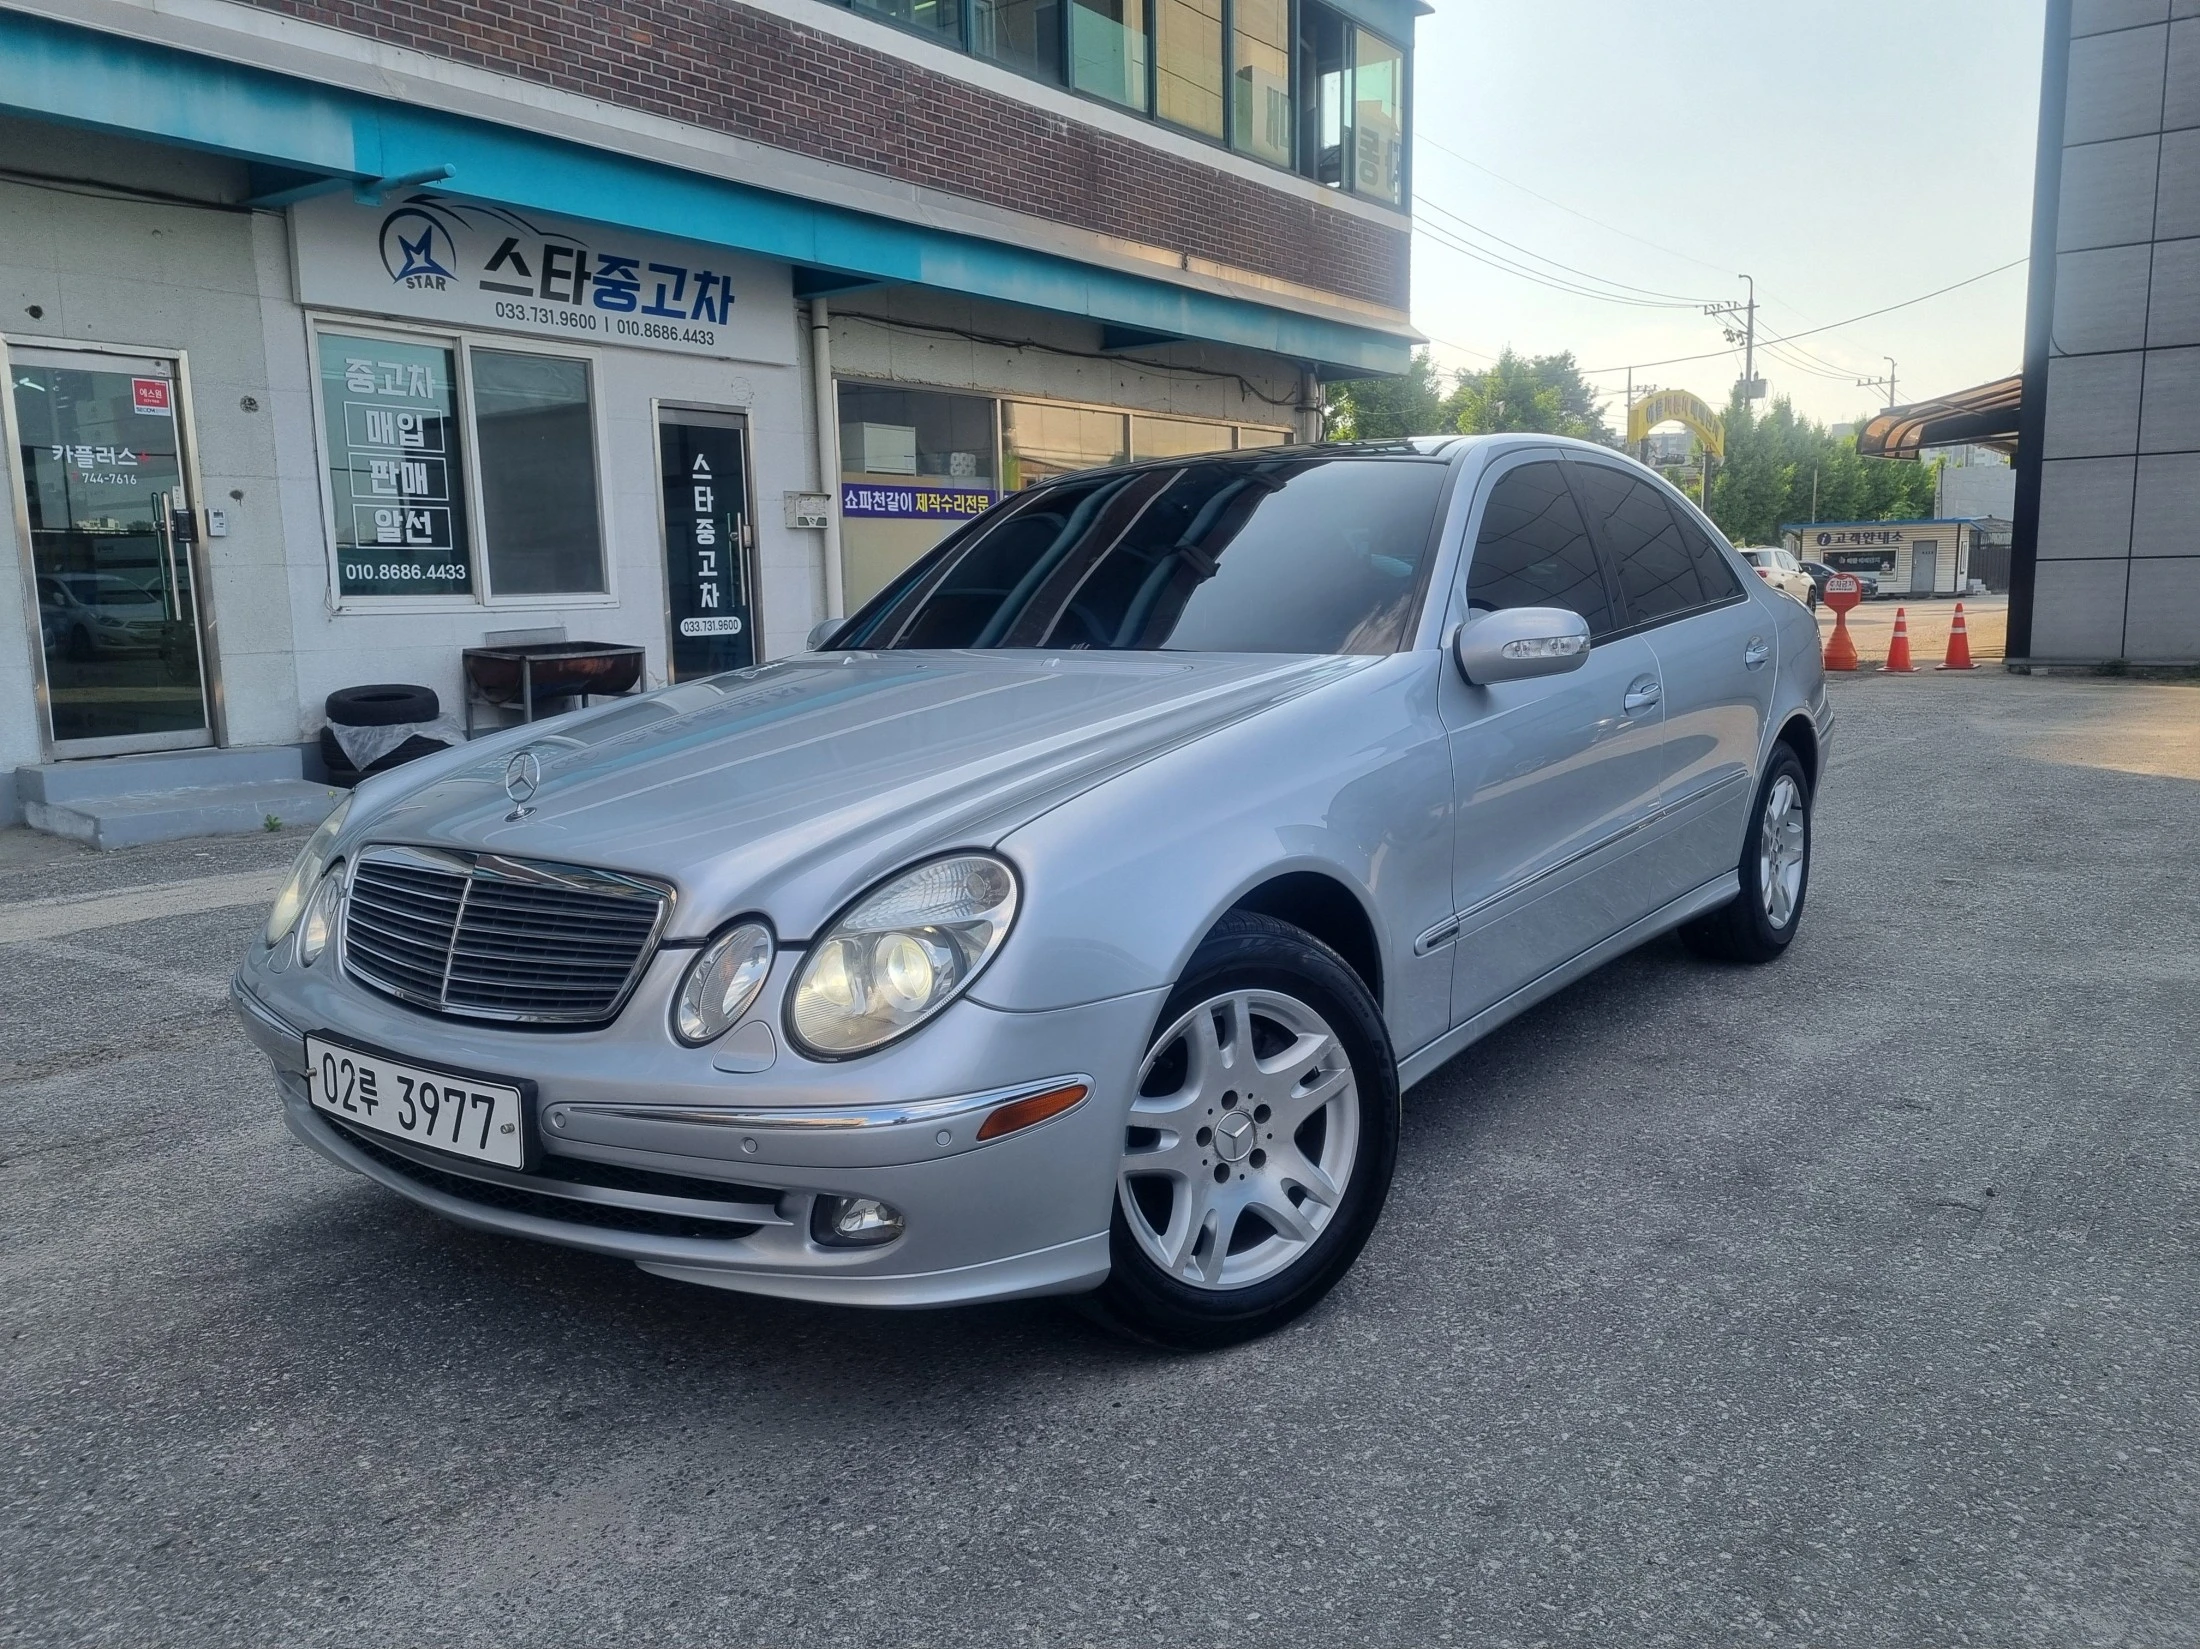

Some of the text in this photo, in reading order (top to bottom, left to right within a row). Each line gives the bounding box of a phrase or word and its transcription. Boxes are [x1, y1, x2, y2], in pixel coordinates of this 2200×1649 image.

[405, 274, 446, 292] STAR
[479, 237, 735, 326] 스타중고차
[495, 301, 597, 331] 033.731.9600
[616, 319, 715, 346] 010.8686.4433
[345, 357, 436, 399] 중고차
[365, 409, 425, 448] 매입
[81, 472, 137, 485] 744-7616
[369, 459, 429, 495] 판매
[844, 490, 989, 514] 쇼파천갈이 제작수리전문
[374, 509, 433, 544] 알선
[692, 453, 720, 608] 스타중고차
[1834, 531, 1904, 545] 고객안내소
[345, 564, 466, 580] 010.8686.4433
[683, 619, 739, 633] 033.731.9600
[322, 1052, 496, 1150] 02루 3977
